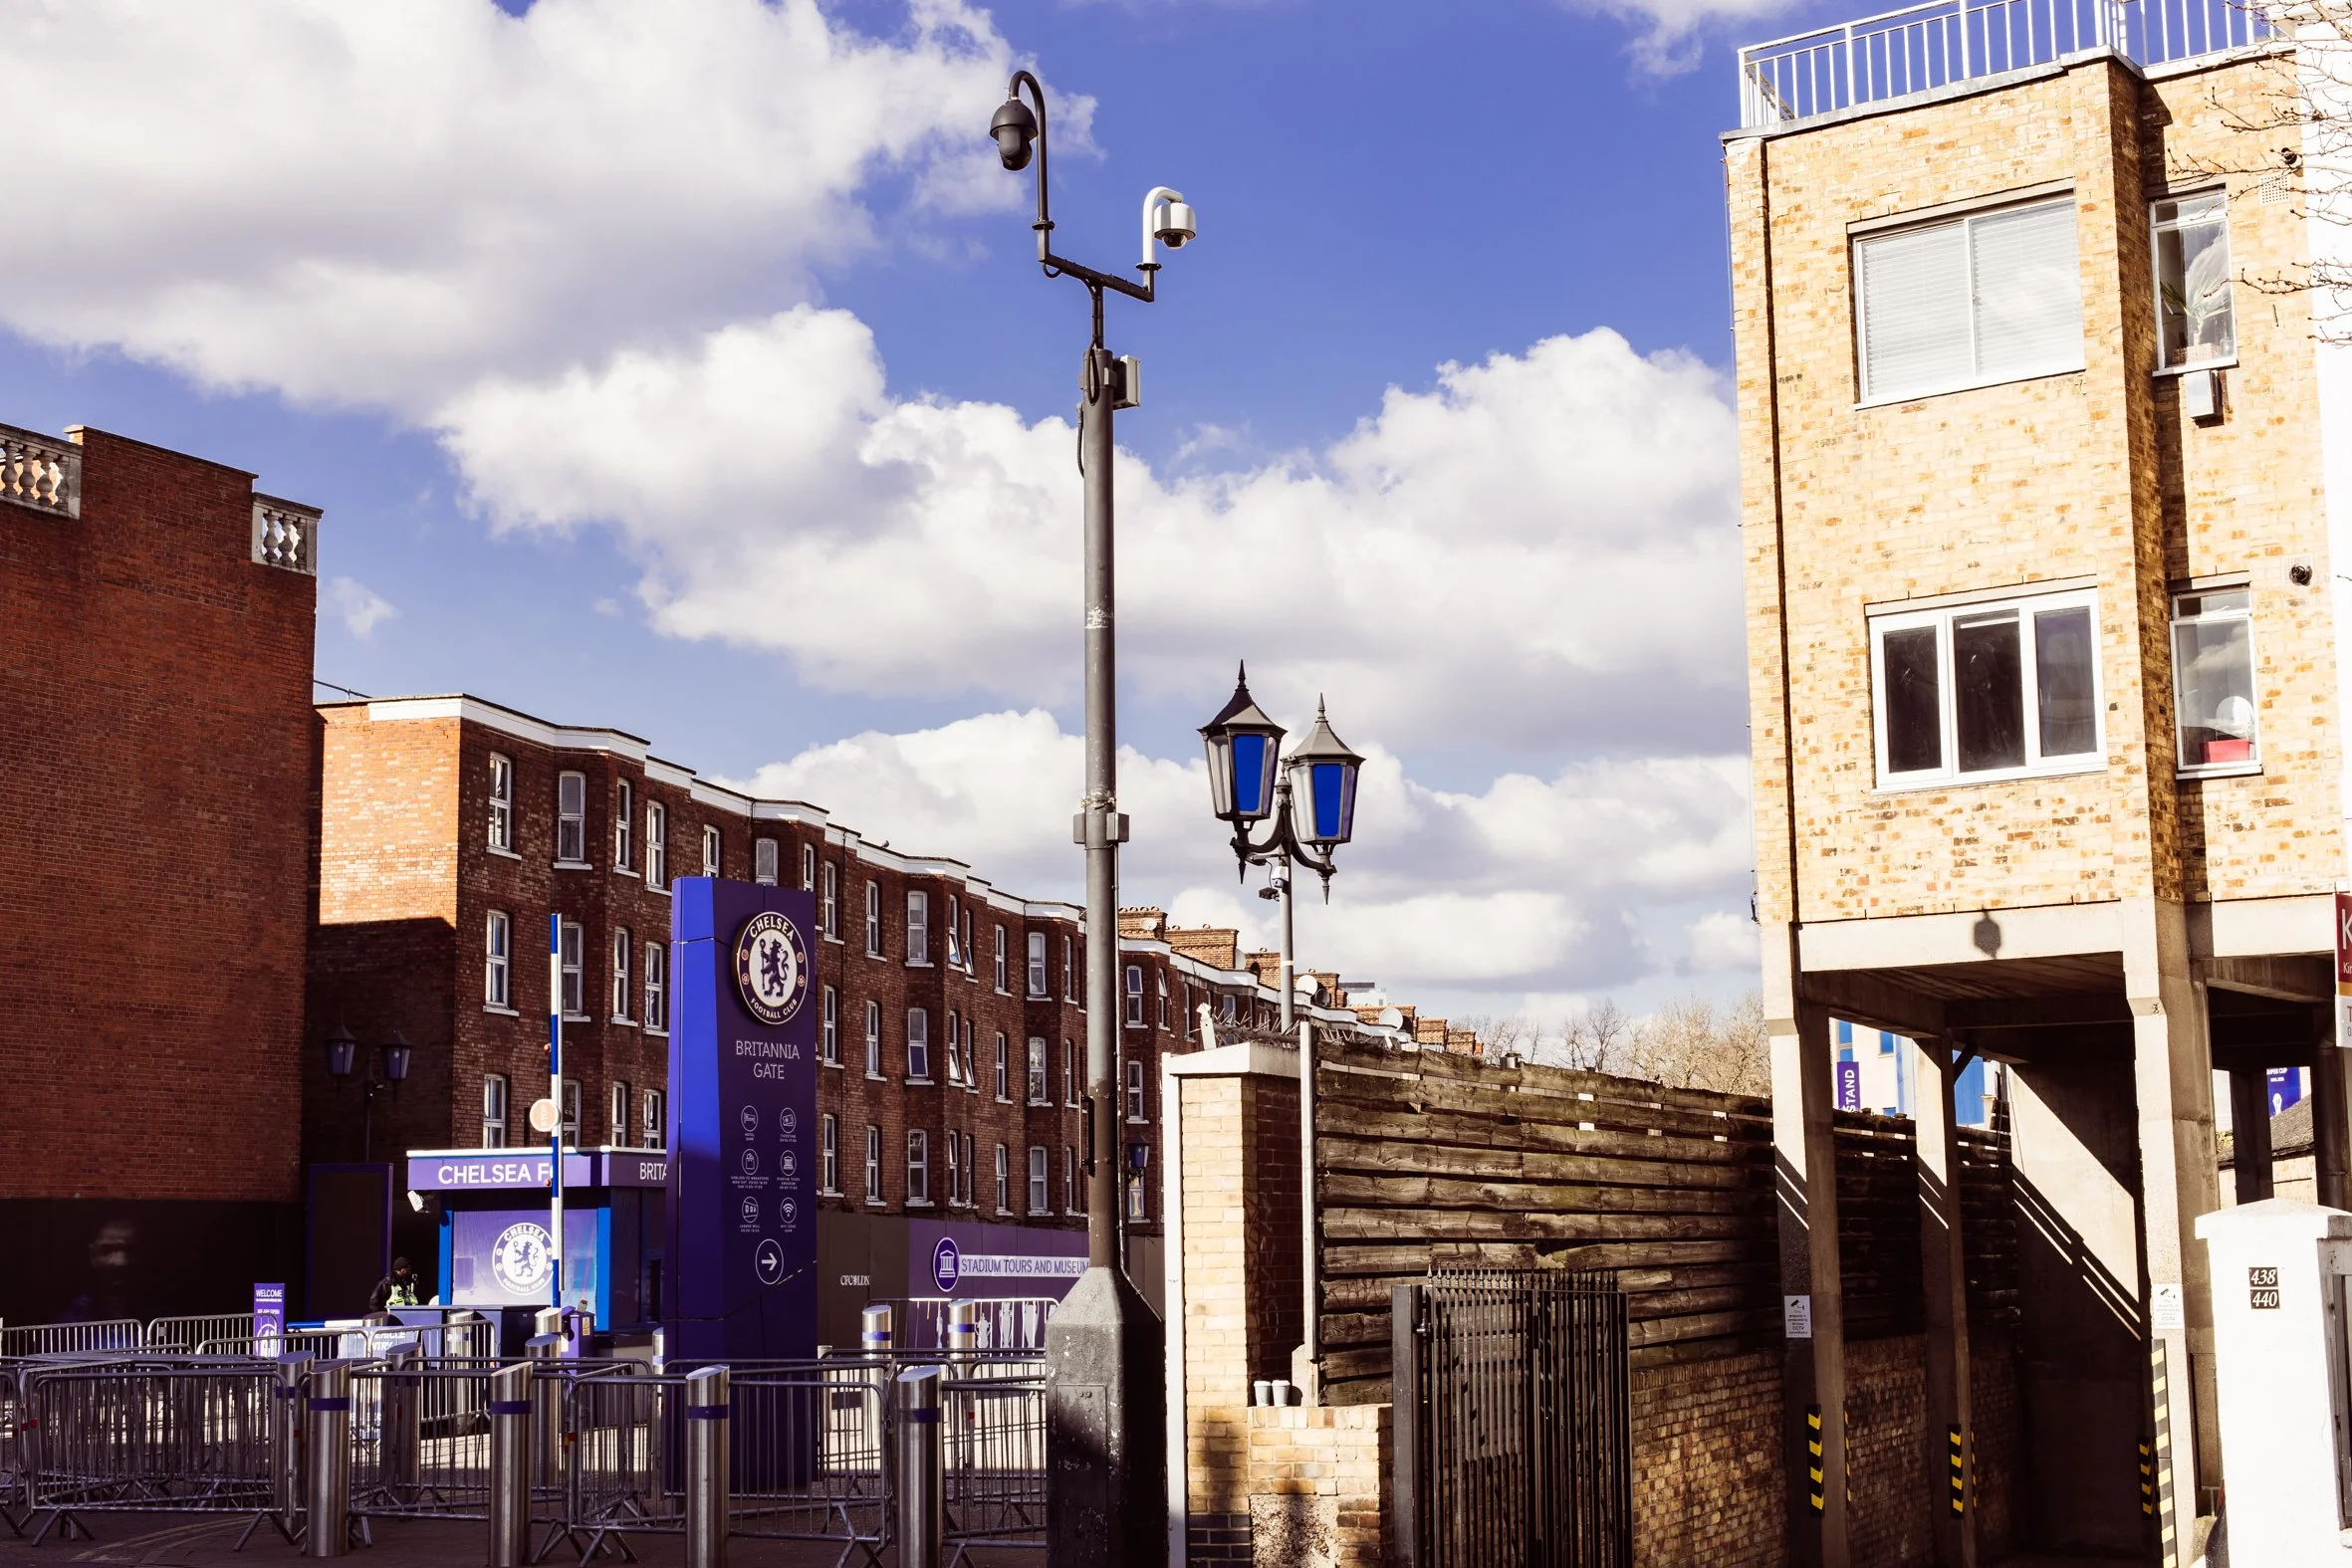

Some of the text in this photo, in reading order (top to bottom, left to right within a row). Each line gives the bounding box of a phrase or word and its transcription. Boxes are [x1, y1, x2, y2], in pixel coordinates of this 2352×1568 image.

[750, 915, 795, 942] CHELSEA
[751, 998, 798, 1018] FOOTBALL CLUB
[736, 1040, 800, 1060] BRITANNIA
[754, 1062, 785, 1080] GATE
[1844, 1069, 1856, 1113] STAND
[438, 1163, 532, 1185] CHELSEA
[504, 1225, 546, 1242] CHELSEA
[961, 1257, 1089, 1274] STADIUM TOURS AND MUSEUM
[2250, 1269, 2276, 1285] 438
[255, 1289, 283, 1298] WELCOME
[2251, 1291, 2278, 1307] 440
